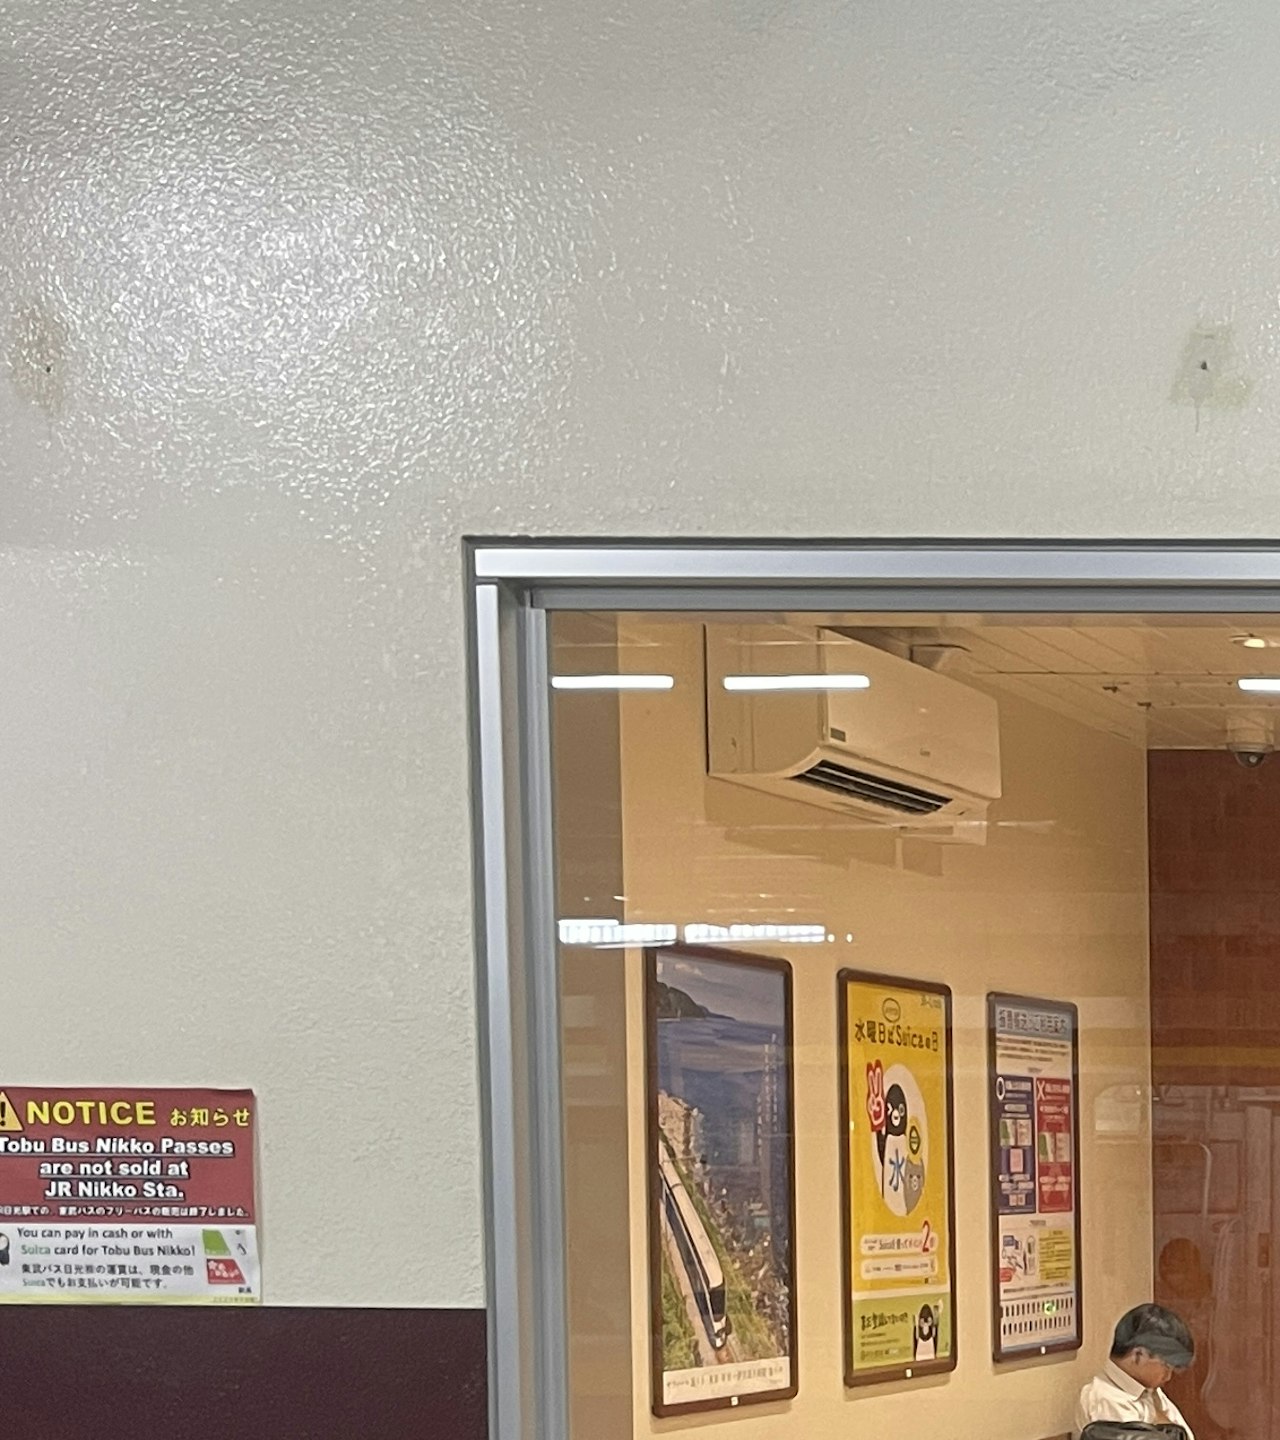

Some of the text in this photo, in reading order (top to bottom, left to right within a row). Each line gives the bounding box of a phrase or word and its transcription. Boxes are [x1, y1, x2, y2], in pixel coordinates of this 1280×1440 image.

[26, 1100, 250, 1127] NOTICE お知らせ
[0, 1136, 234, 1154] Tobu Bus Nikko Passes
[40, 1160, 189, 1176] are not sold at
[44, 1181, 185, 1198] JR Nikko Sta.
[17, 1227, 173, 1240] You can pay in cash or with
[21, 1244, 195, 1257] Suica card for Tobu Bus Nikko!
